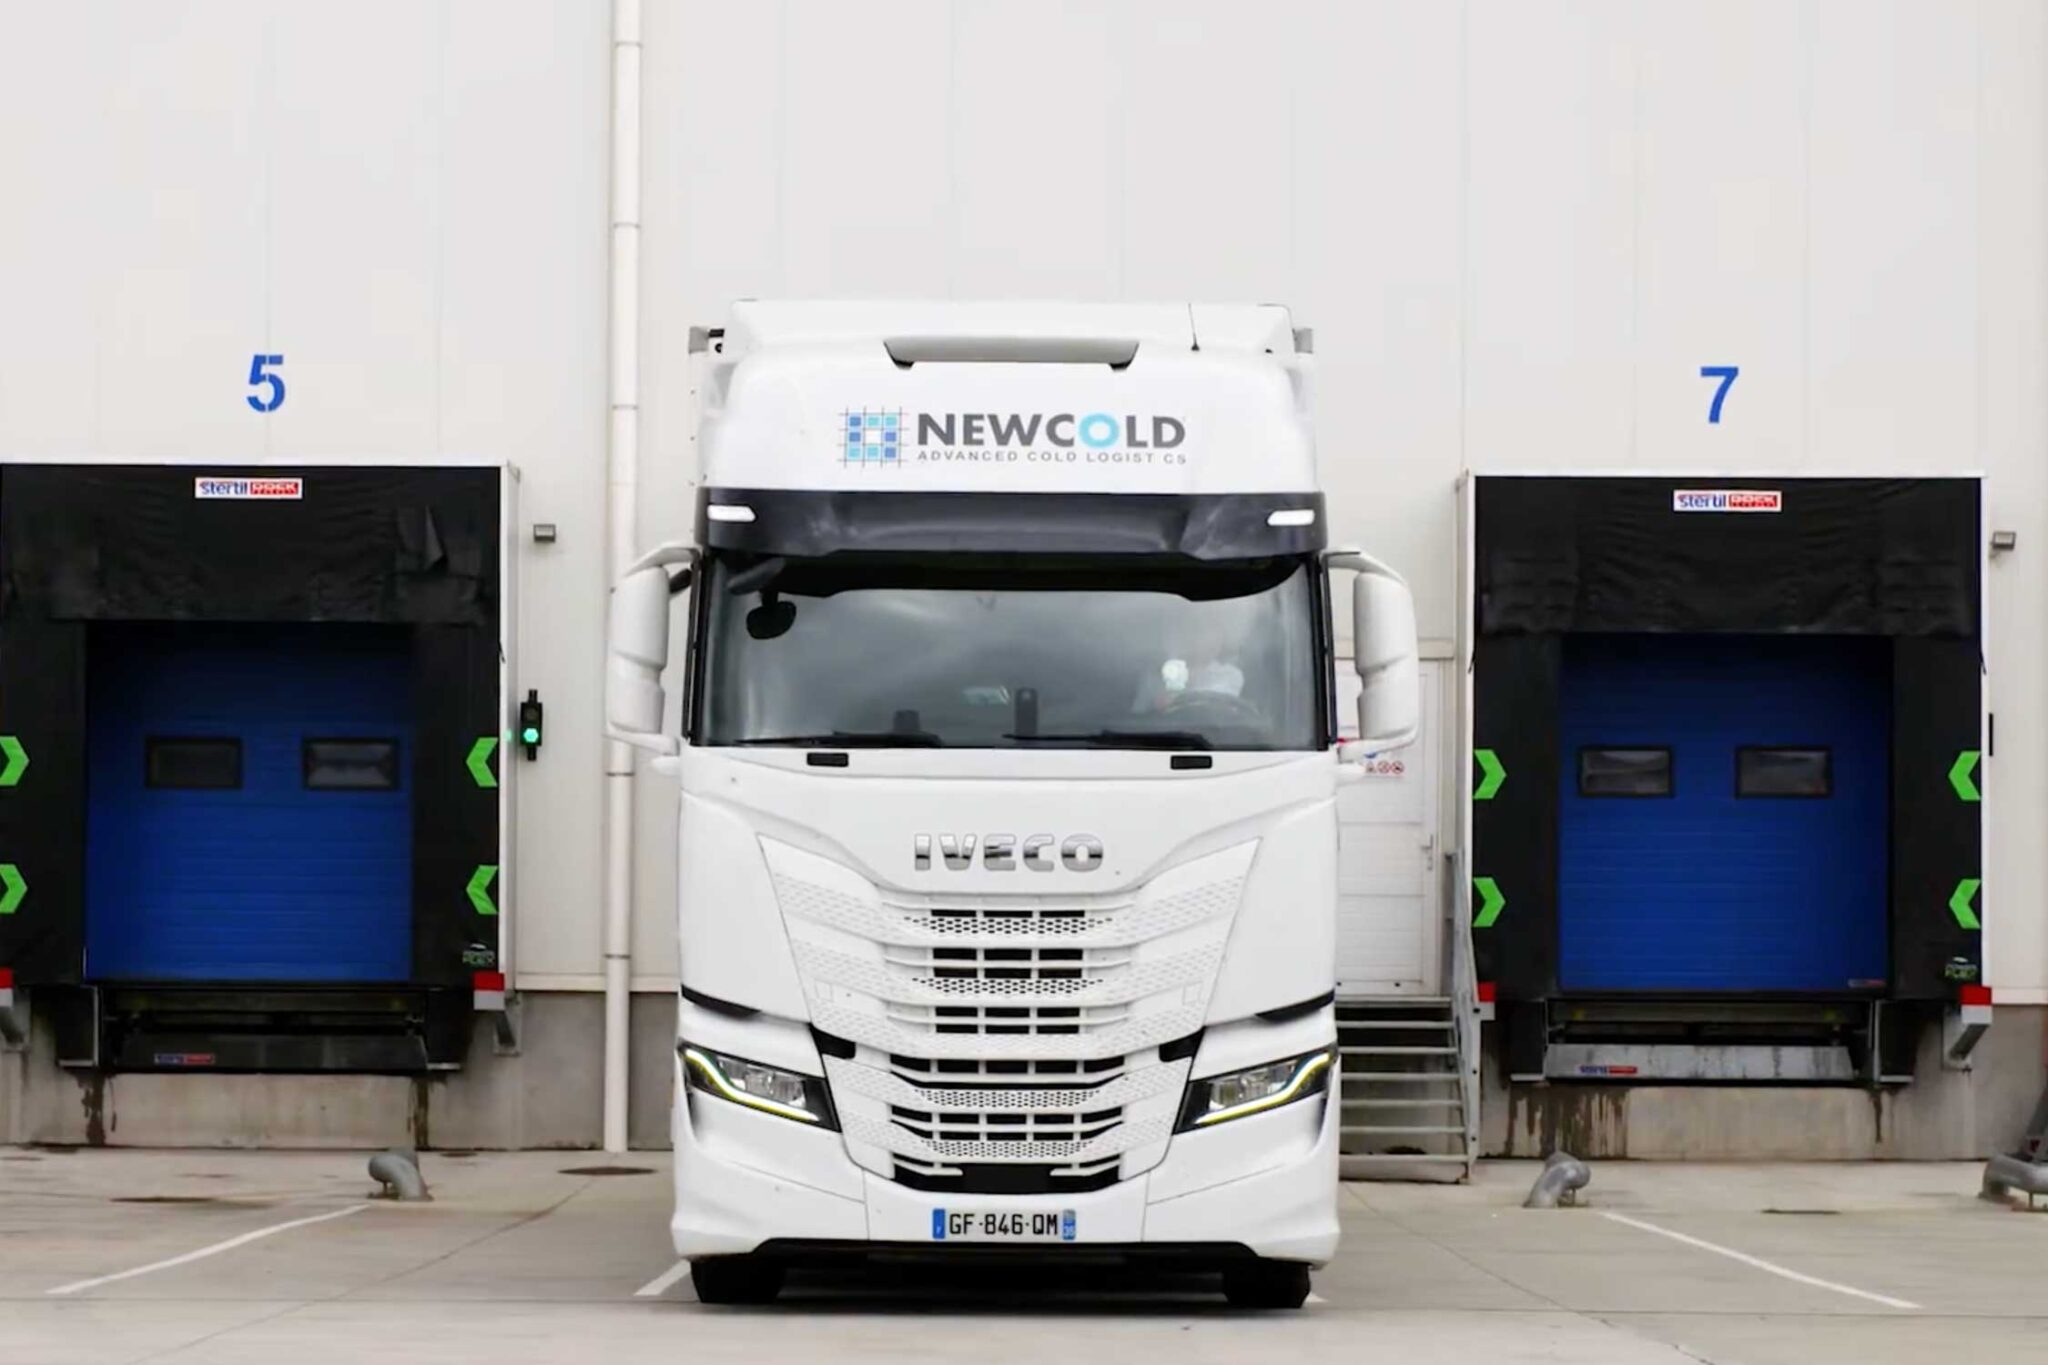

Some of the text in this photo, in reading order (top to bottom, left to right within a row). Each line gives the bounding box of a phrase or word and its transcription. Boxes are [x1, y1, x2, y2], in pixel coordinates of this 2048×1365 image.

[246, 354, 286, 413] 5
[1700, 366, 1739, 424] 7
[917, 412, 1186, 449] NEWCOLD
[917, 450, 1187, 465] ADVANCED COLD LOGISTCS
[914, 833, 1104, 872] IVECO
